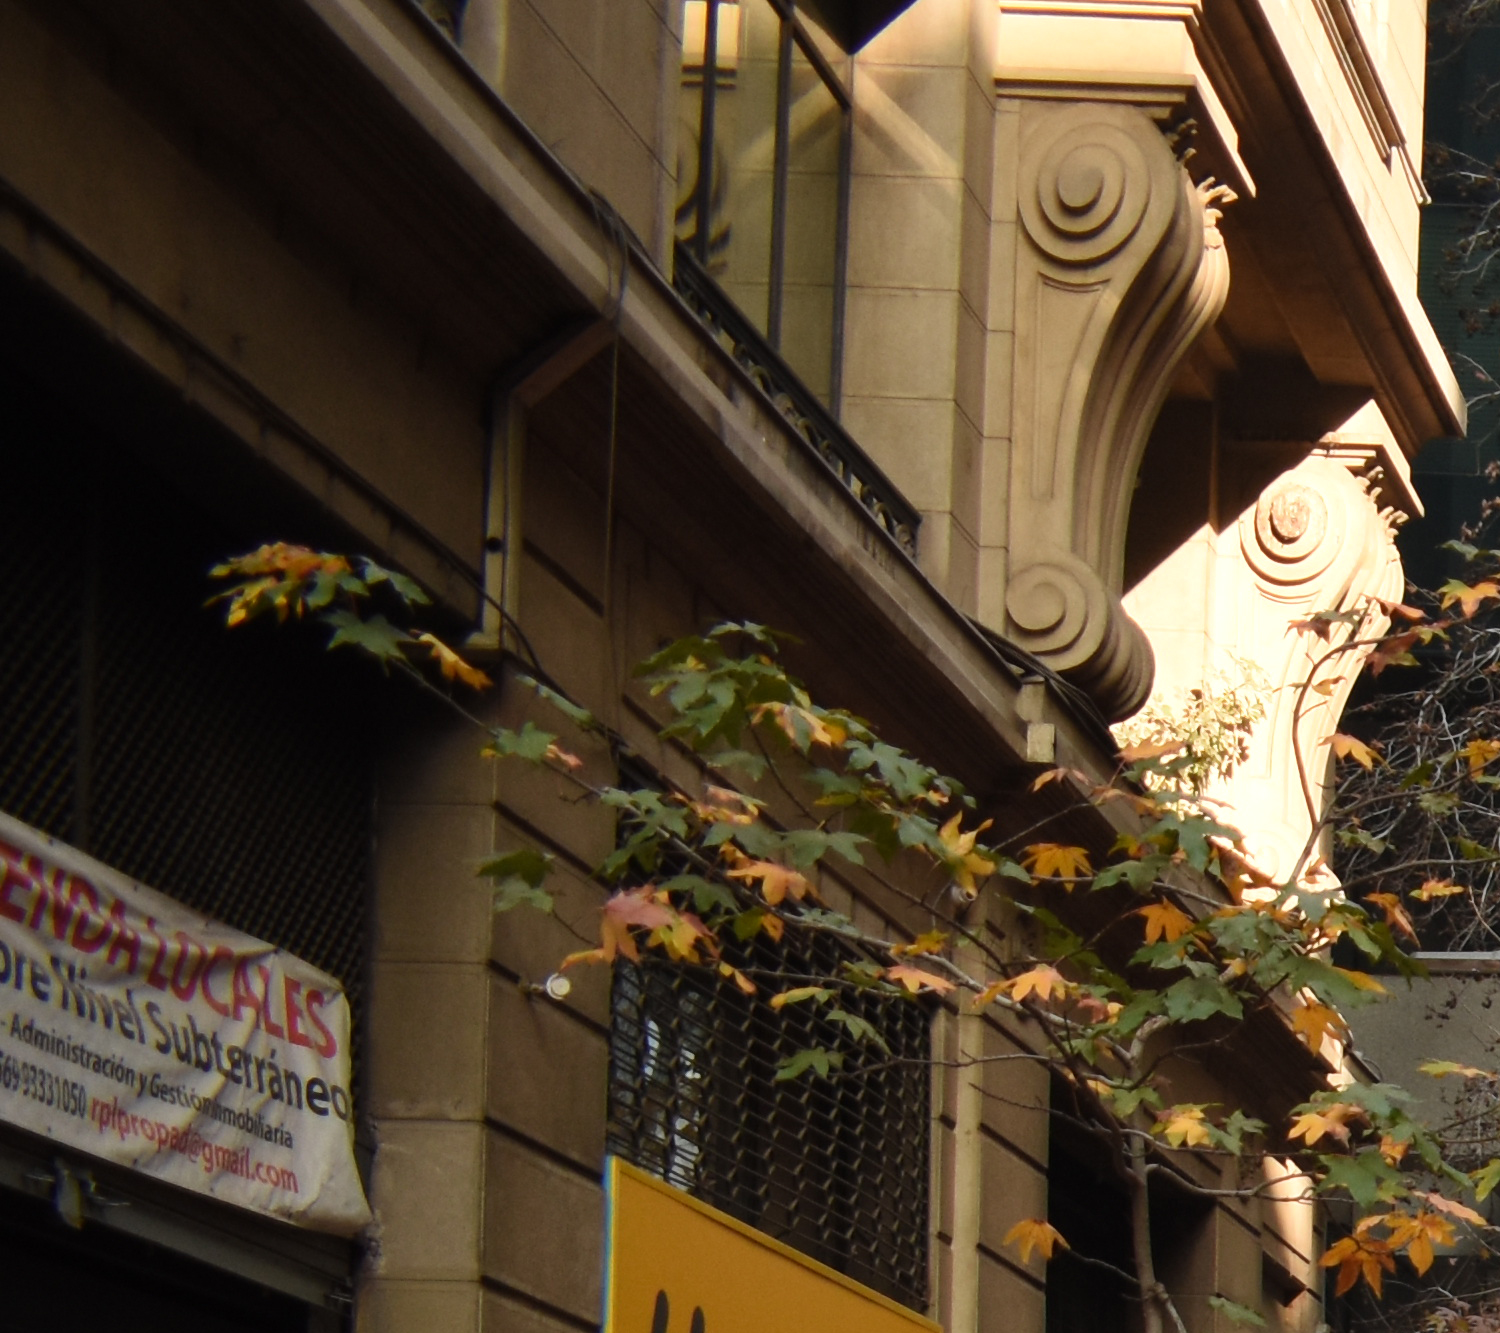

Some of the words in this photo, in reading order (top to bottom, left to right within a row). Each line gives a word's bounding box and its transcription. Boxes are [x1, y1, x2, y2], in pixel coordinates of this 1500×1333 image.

[10, 1013, 136, 1085] Administración
[137, 1072, 148, 1098] y
[50, 955, 146, 1045] Nivel
[145, 1001, 349, 1121] Subterráneo
[147, 915, 338, 1059] LOCALES
